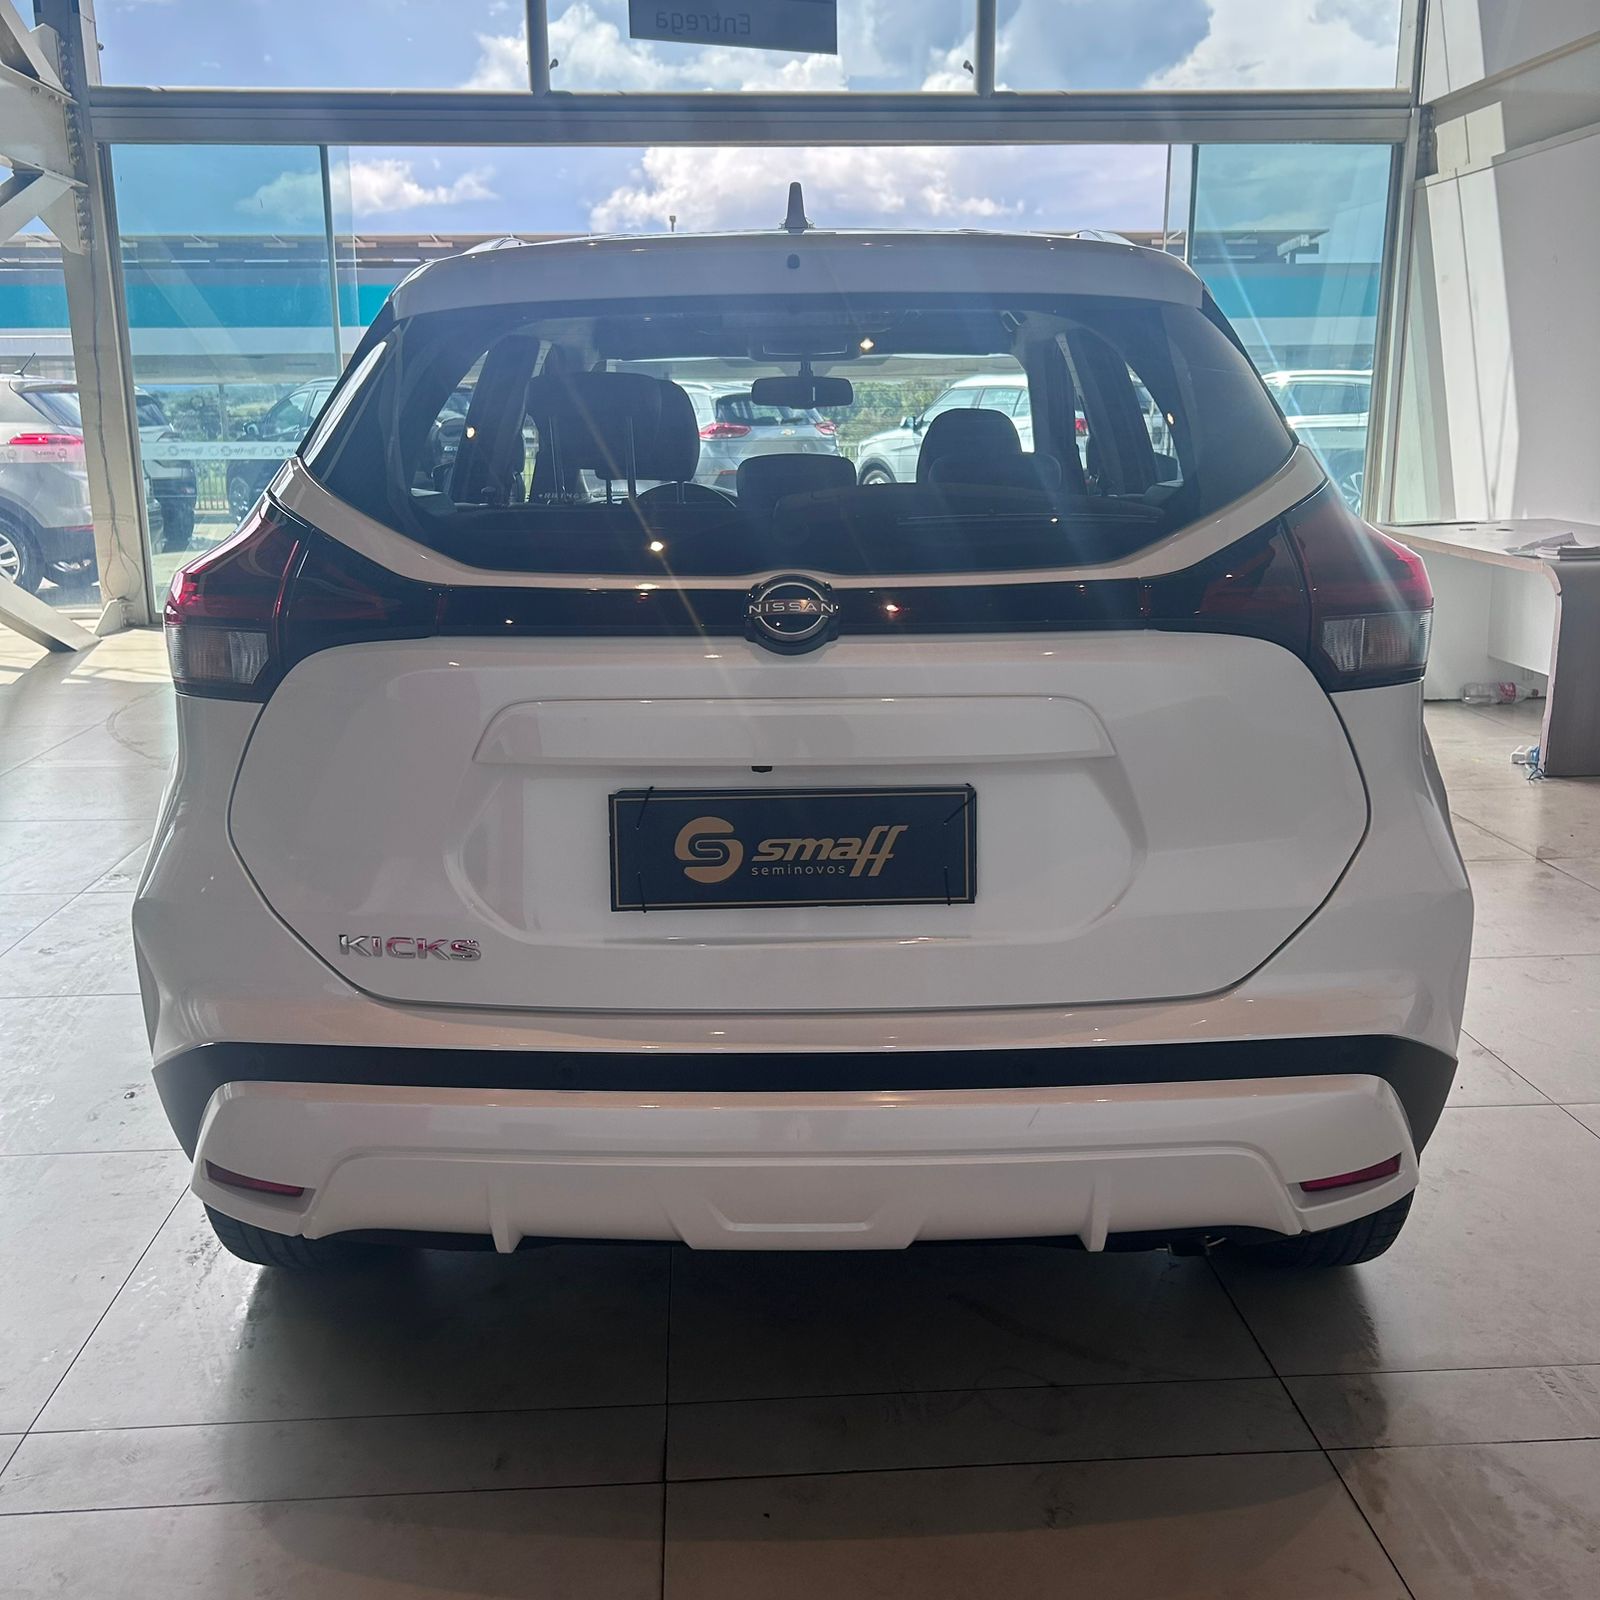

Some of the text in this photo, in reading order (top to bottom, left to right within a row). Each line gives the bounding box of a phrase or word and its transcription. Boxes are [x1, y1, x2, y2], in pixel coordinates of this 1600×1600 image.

[748, 602, 834, 614] NISSAN
[751, 825, 909, 877] smaff
[751, 863, 847, 876] seminovos
[338, 934, 482, 961] KICKS
